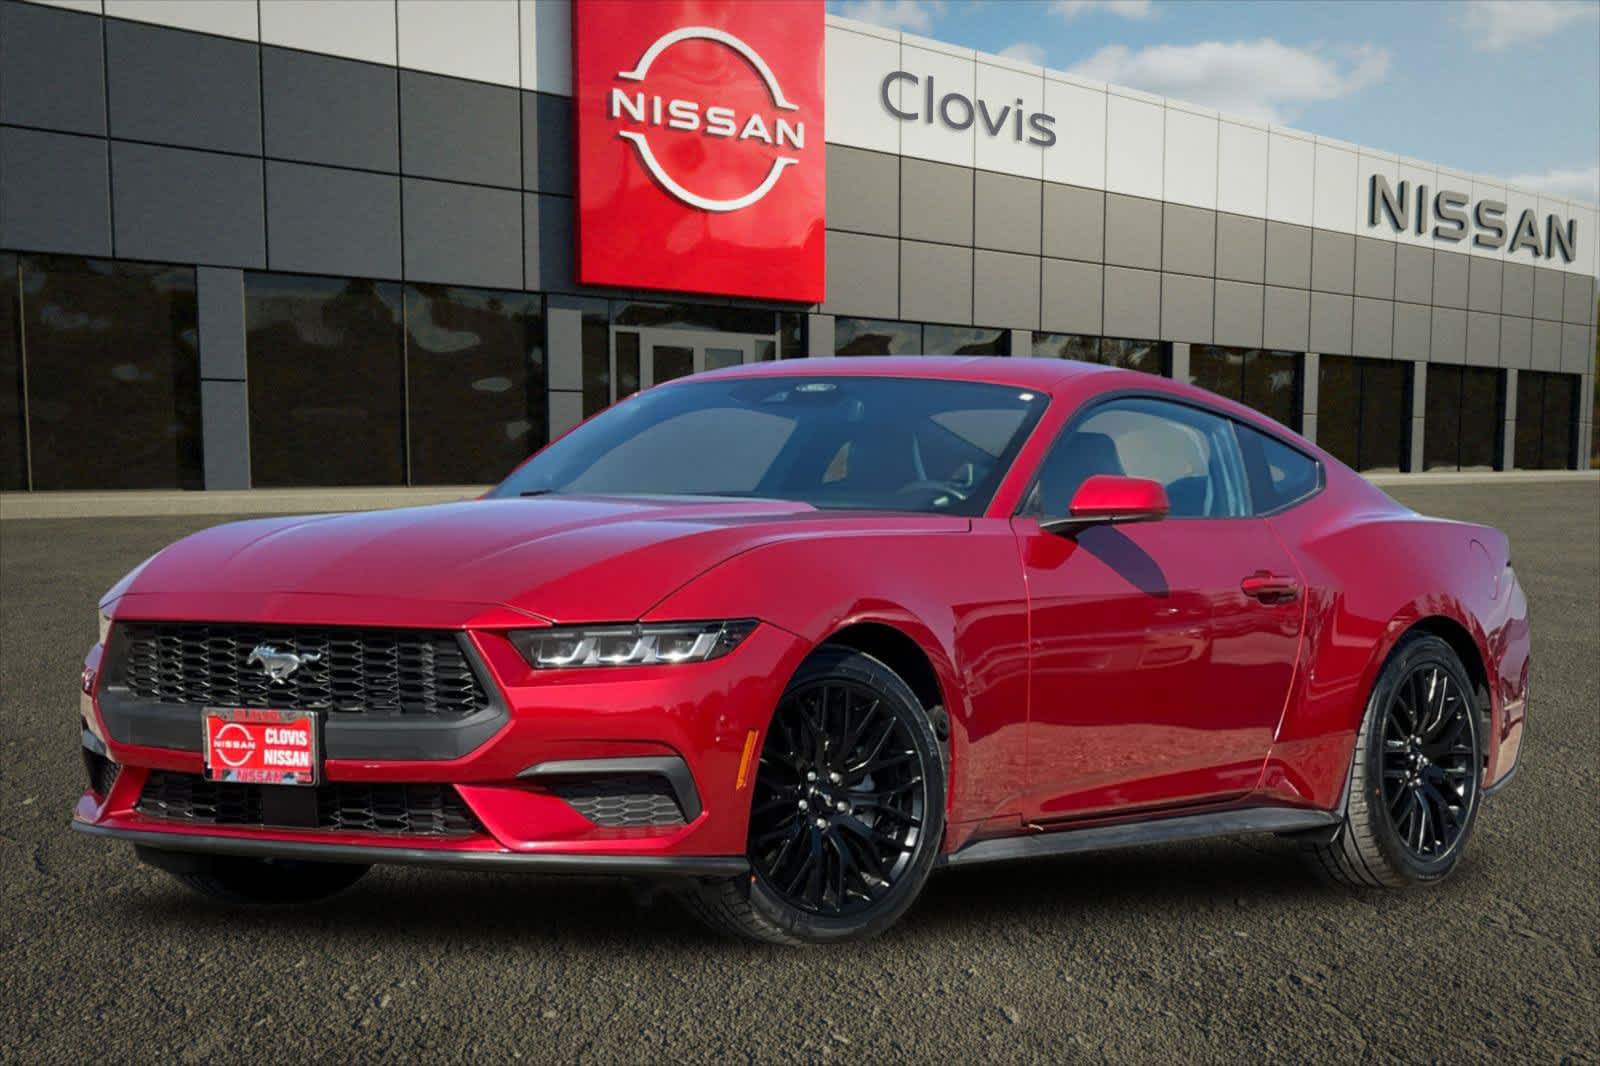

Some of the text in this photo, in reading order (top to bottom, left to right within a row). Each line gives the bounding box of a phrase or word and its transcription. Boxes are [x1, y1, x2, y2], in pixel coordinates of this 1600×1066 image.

[611, 88, 805, 148] NISSAN
[881, 71, 1056, 148] Clovis
[1368, 173, 1578, 263] NISSAN
[213, 740, 256, 750] NISSAN
[265, 728, 307, 746] CLOVIS
[264, 749, 309, 766] NISSAN
